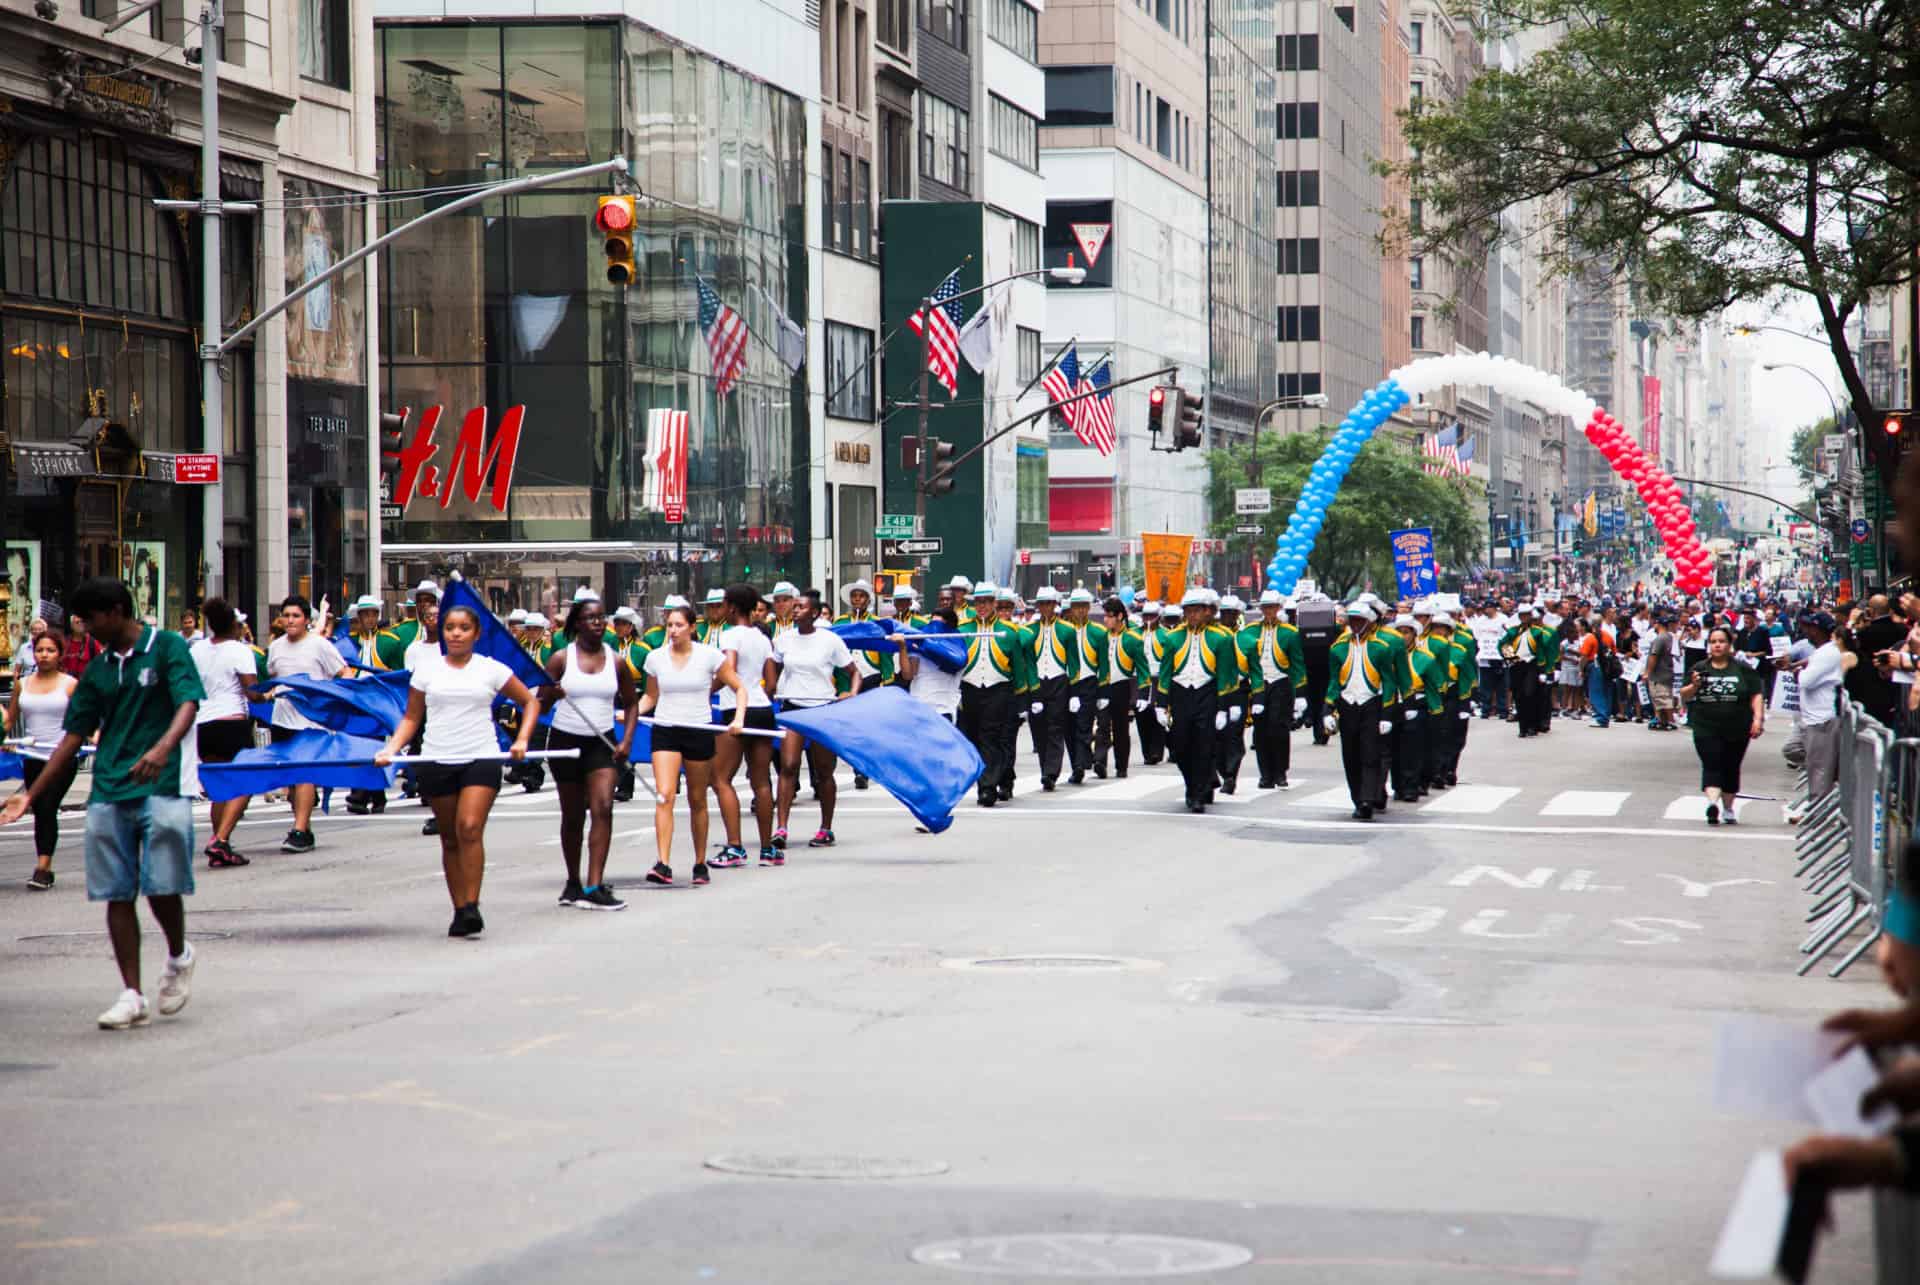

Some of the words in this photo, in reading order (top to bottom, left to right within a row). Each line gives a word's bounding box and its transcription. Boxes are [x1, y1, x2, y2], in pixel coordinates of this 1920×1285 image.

[310, 416, 322, 432] TED
[31, 456, 82, 475] SEPHORA
[177, 456, 186, 464] NO
[188, 456, 217, 464] STANDING
[381, 404, 526, 513] H&M
[182, 464, 212, 472] ANYTIME
[1449, 865, 1776, 898] NLY
